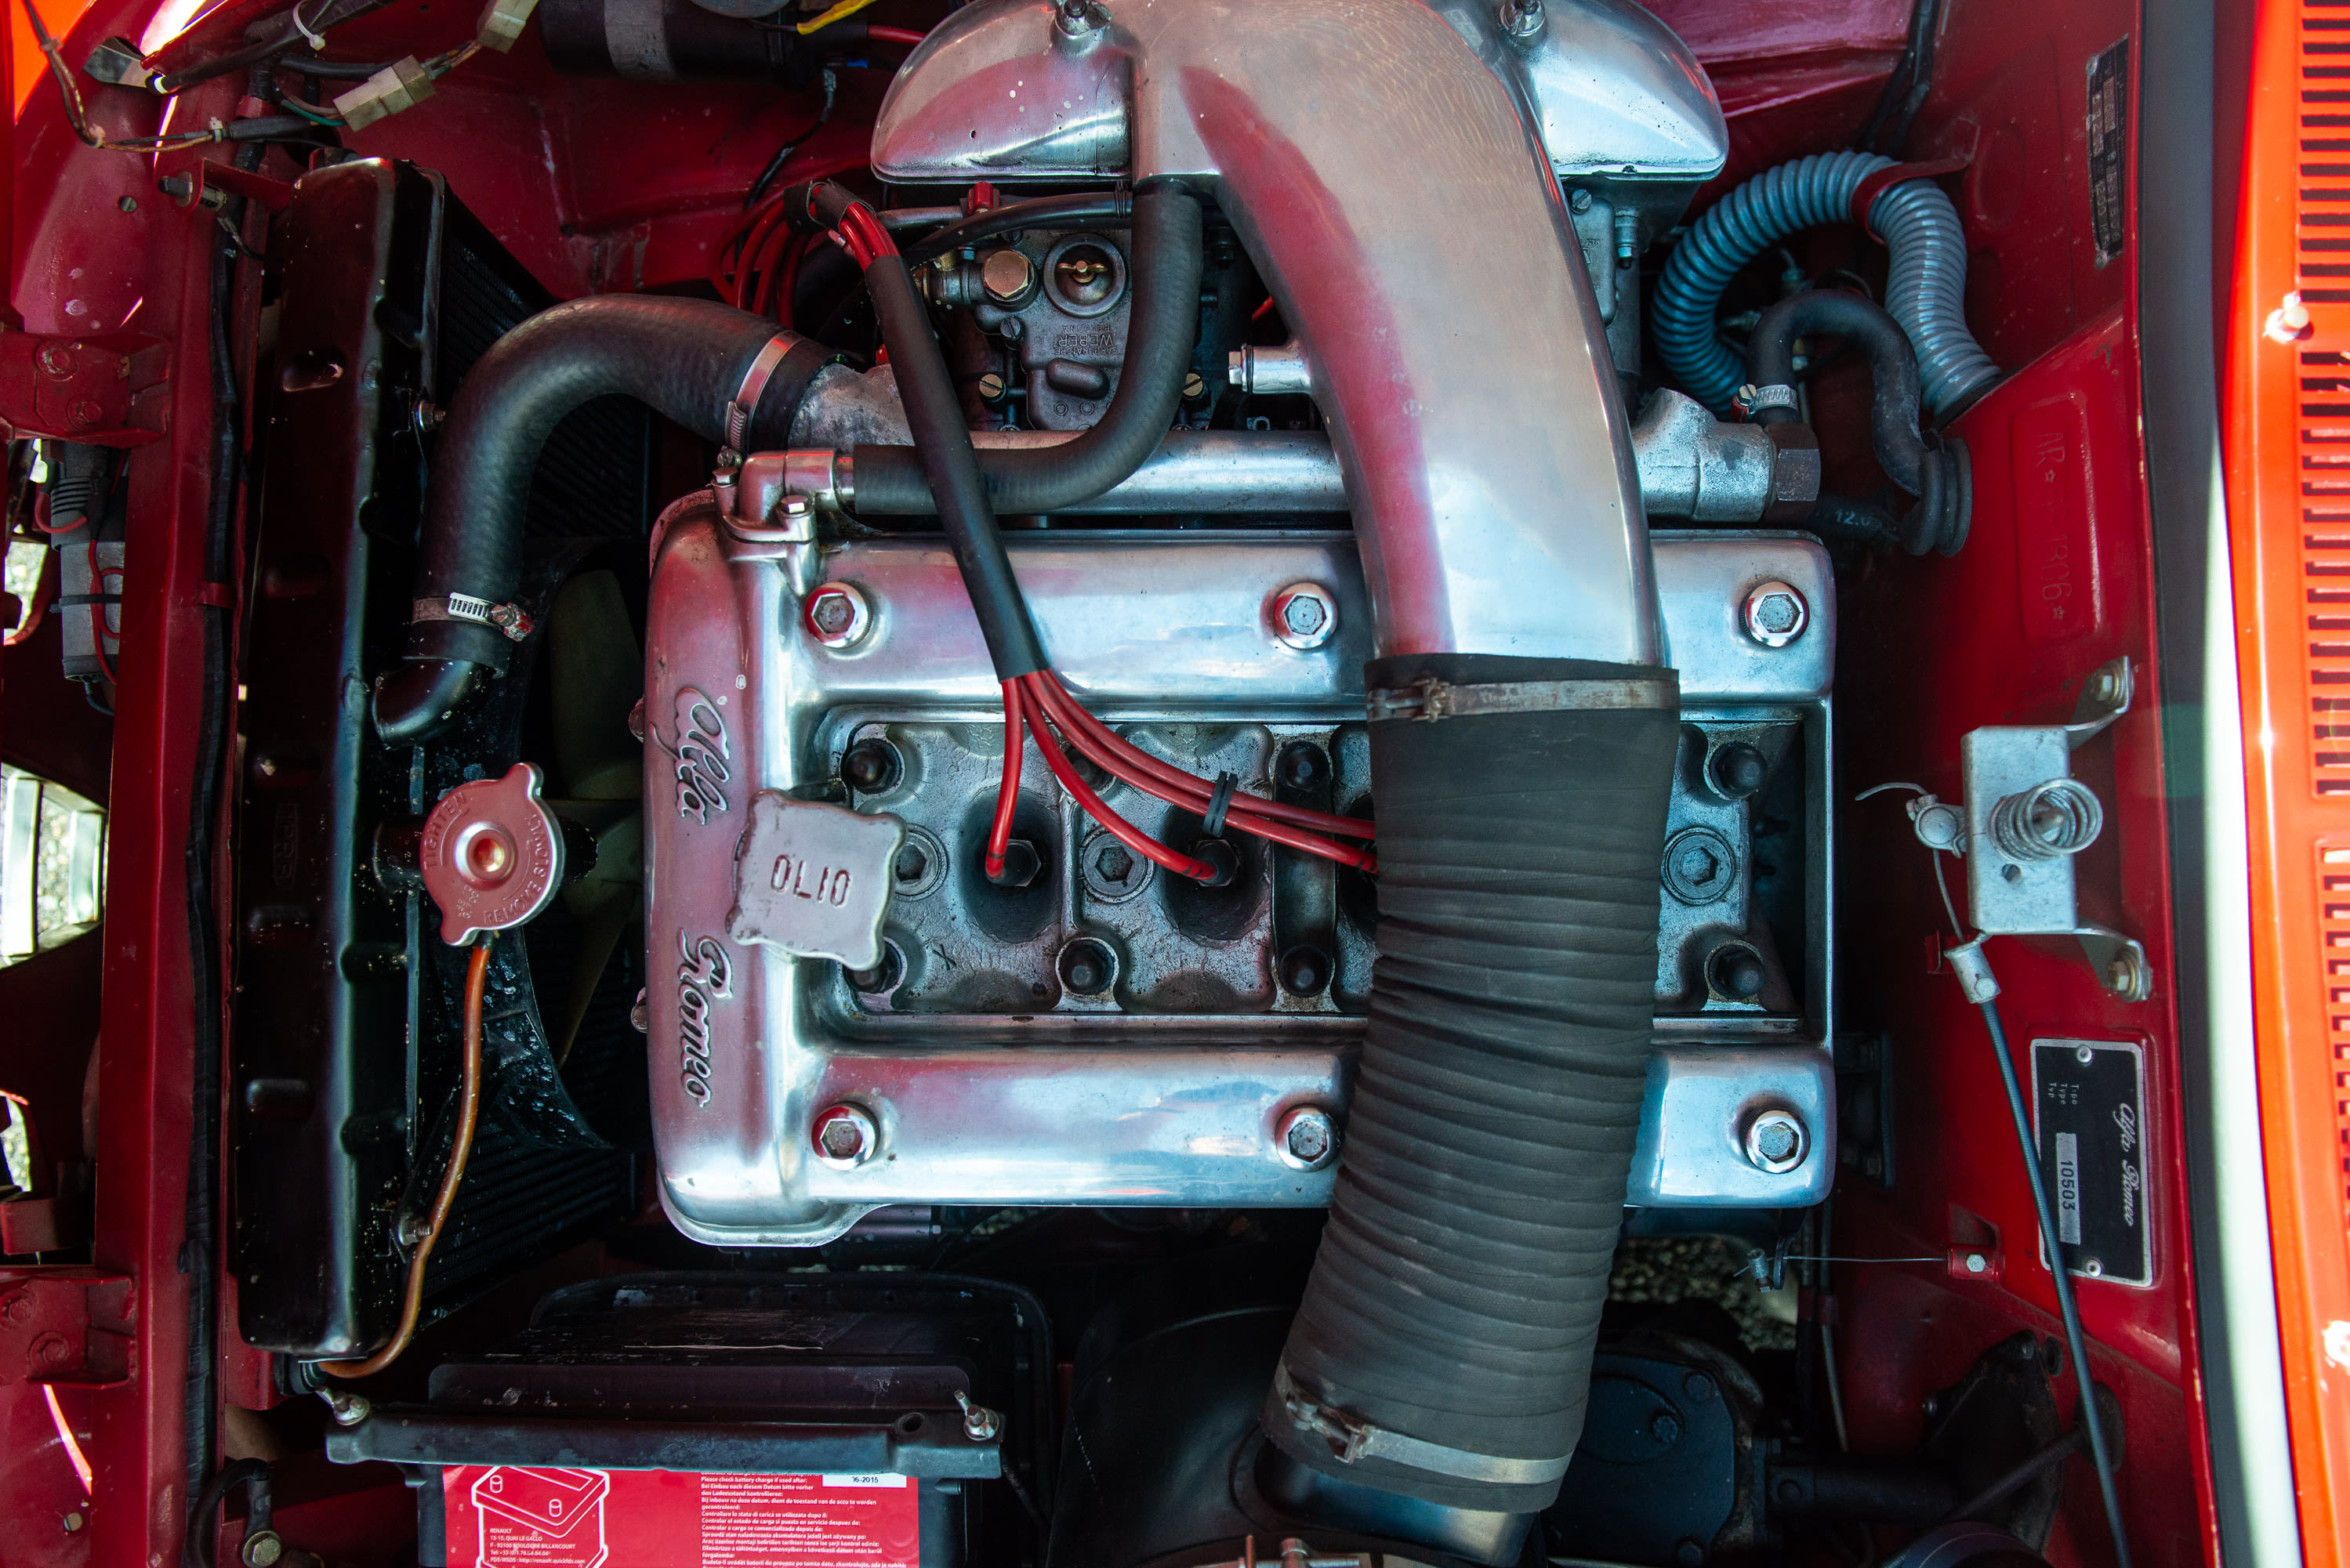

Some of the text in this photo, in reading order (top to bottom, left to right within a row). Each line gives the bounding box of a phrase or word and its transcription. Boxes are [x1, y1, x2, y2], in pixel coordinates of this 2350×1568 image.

[1058, 335, 1113, 346] WEBER
[424, 791, 466, 871] TIGHTEN
[483, 880, 542, 925] REMOVE
[649, 687, 733, 1108] Alfa Romeo
[770, 853, 853, 908] OLIO
[2060, 1160, 2076, 1211] 10503
[2112, 1103, 2140, 1227] Alfa Romeo
